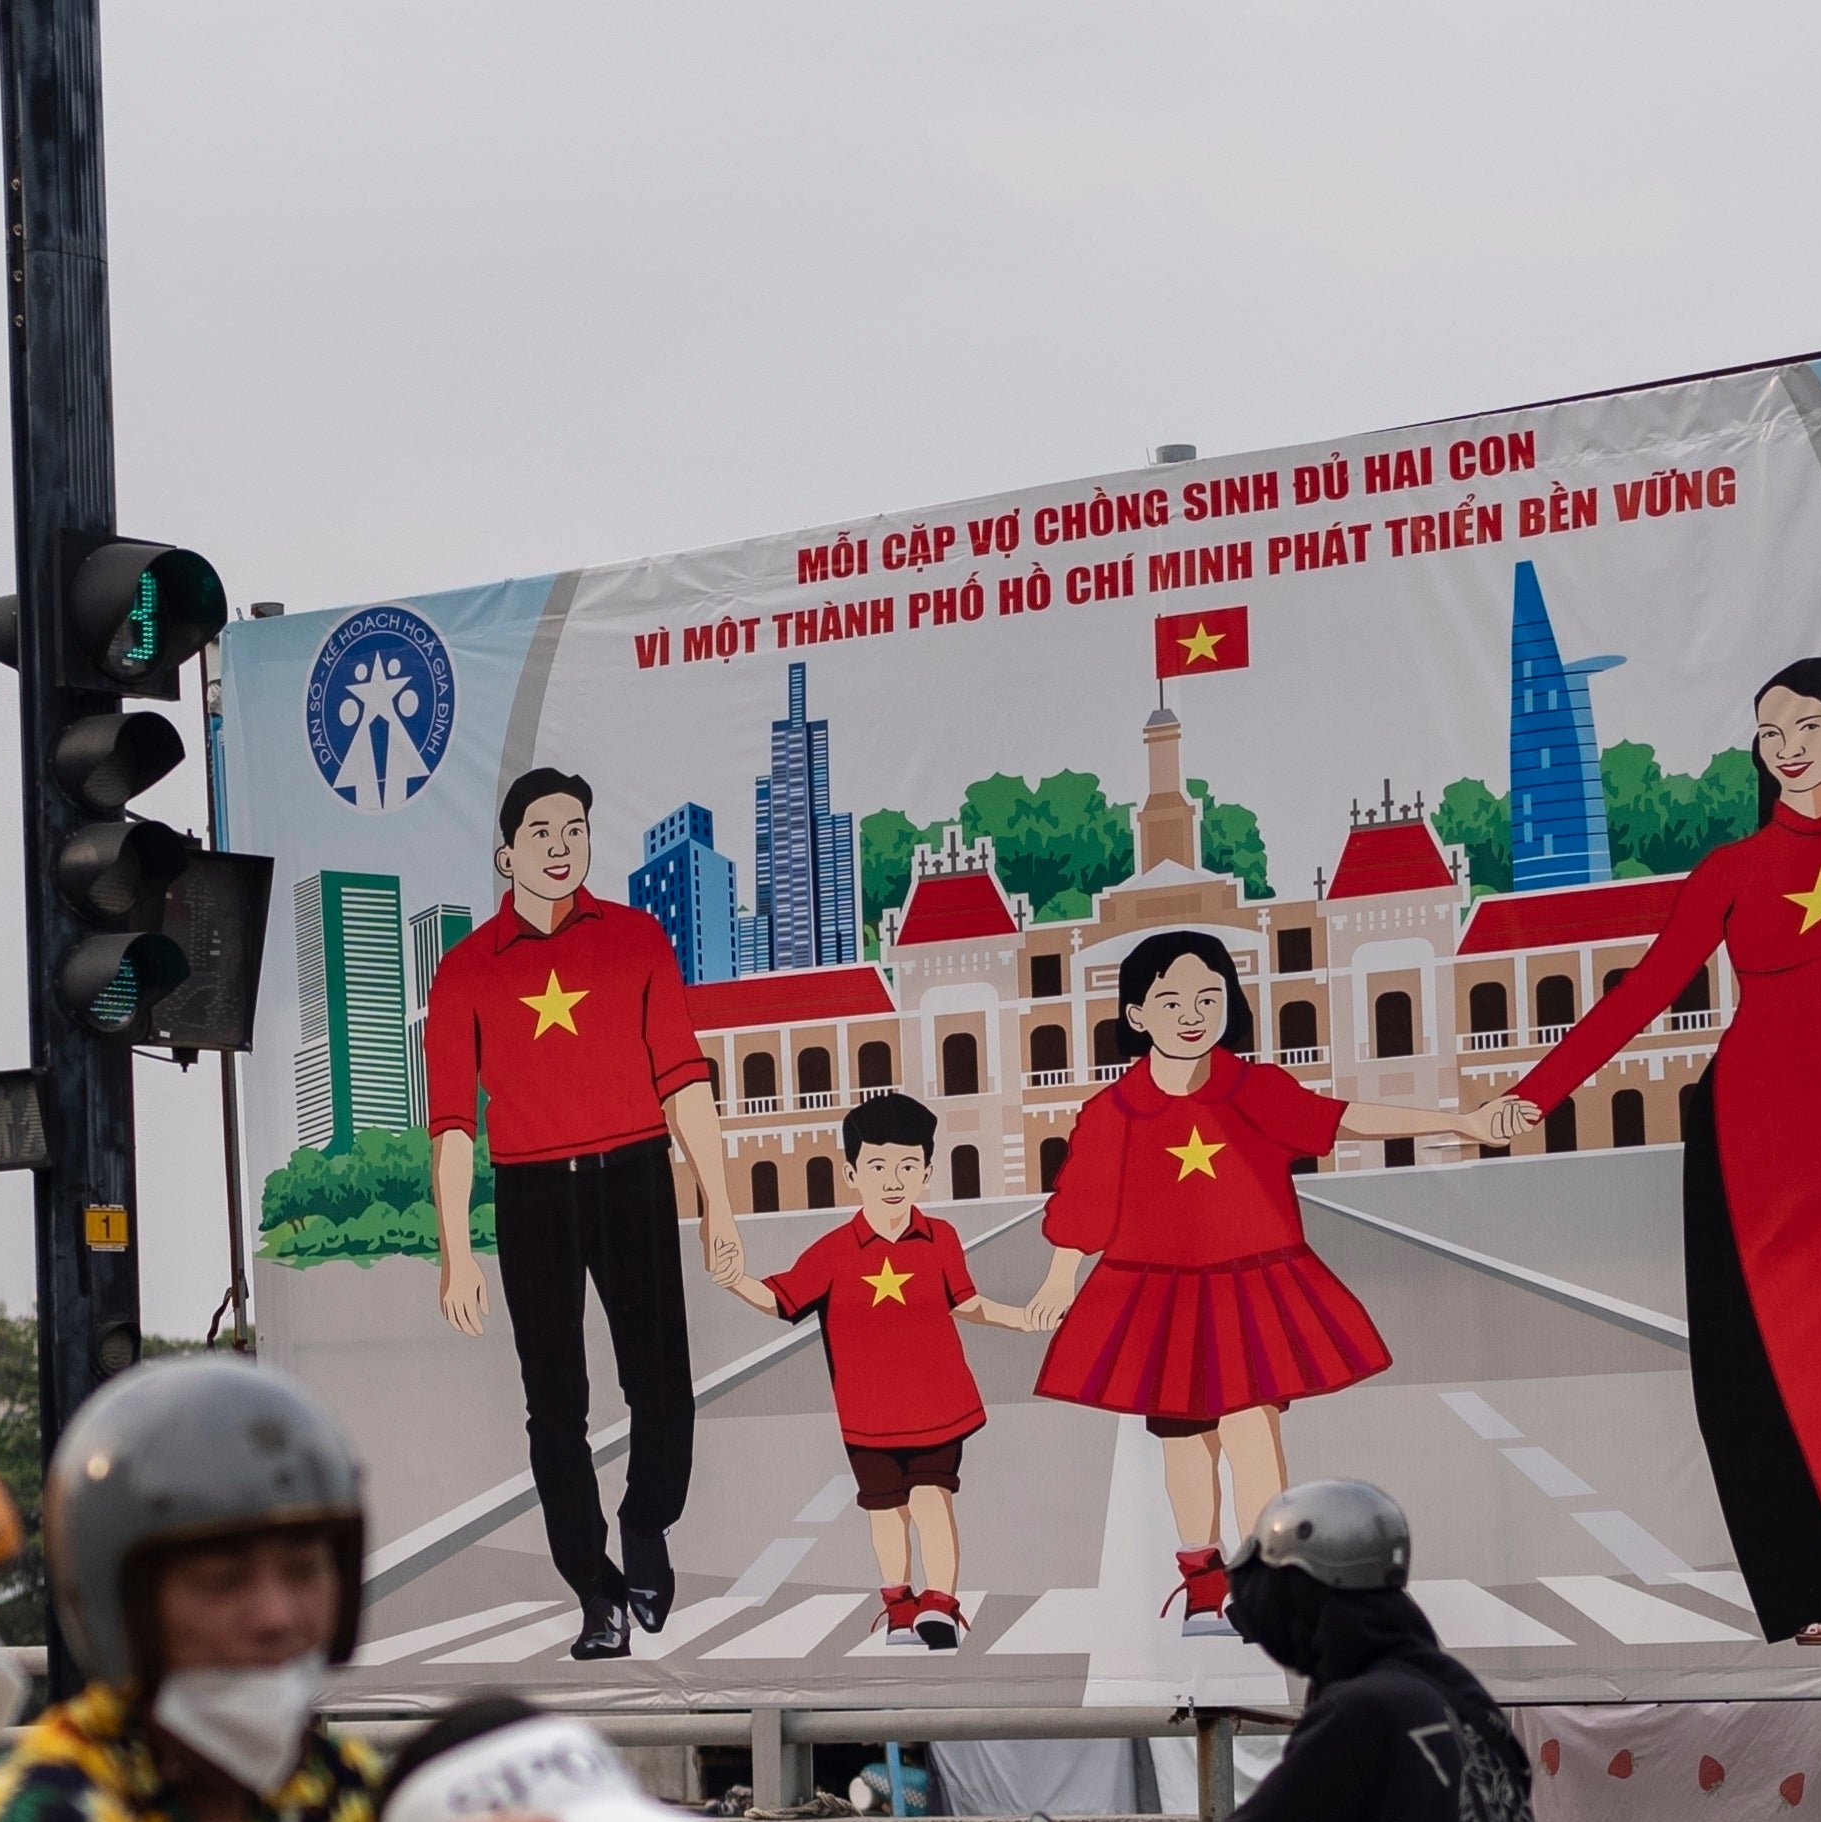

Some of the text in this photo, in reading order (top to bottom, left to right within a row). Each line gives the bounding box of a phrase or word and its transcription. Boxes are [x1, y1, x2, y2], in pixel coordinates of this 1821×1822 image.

[797, 430, 1536, 585] MỖI CẶP VỢ CHỒNG SINH ĐỦ HAI CON
[634, 465, 1737, 670] VÌ MỘT THÀNH PHỐ HỒ CHÍ MINH PHÁT TRIỂN BỀN VỮNG
[338, 613, 400, 645] HOẠCH
[432, 658, 449, 696] GIA
[101, 1214, 111, 1239] 1
